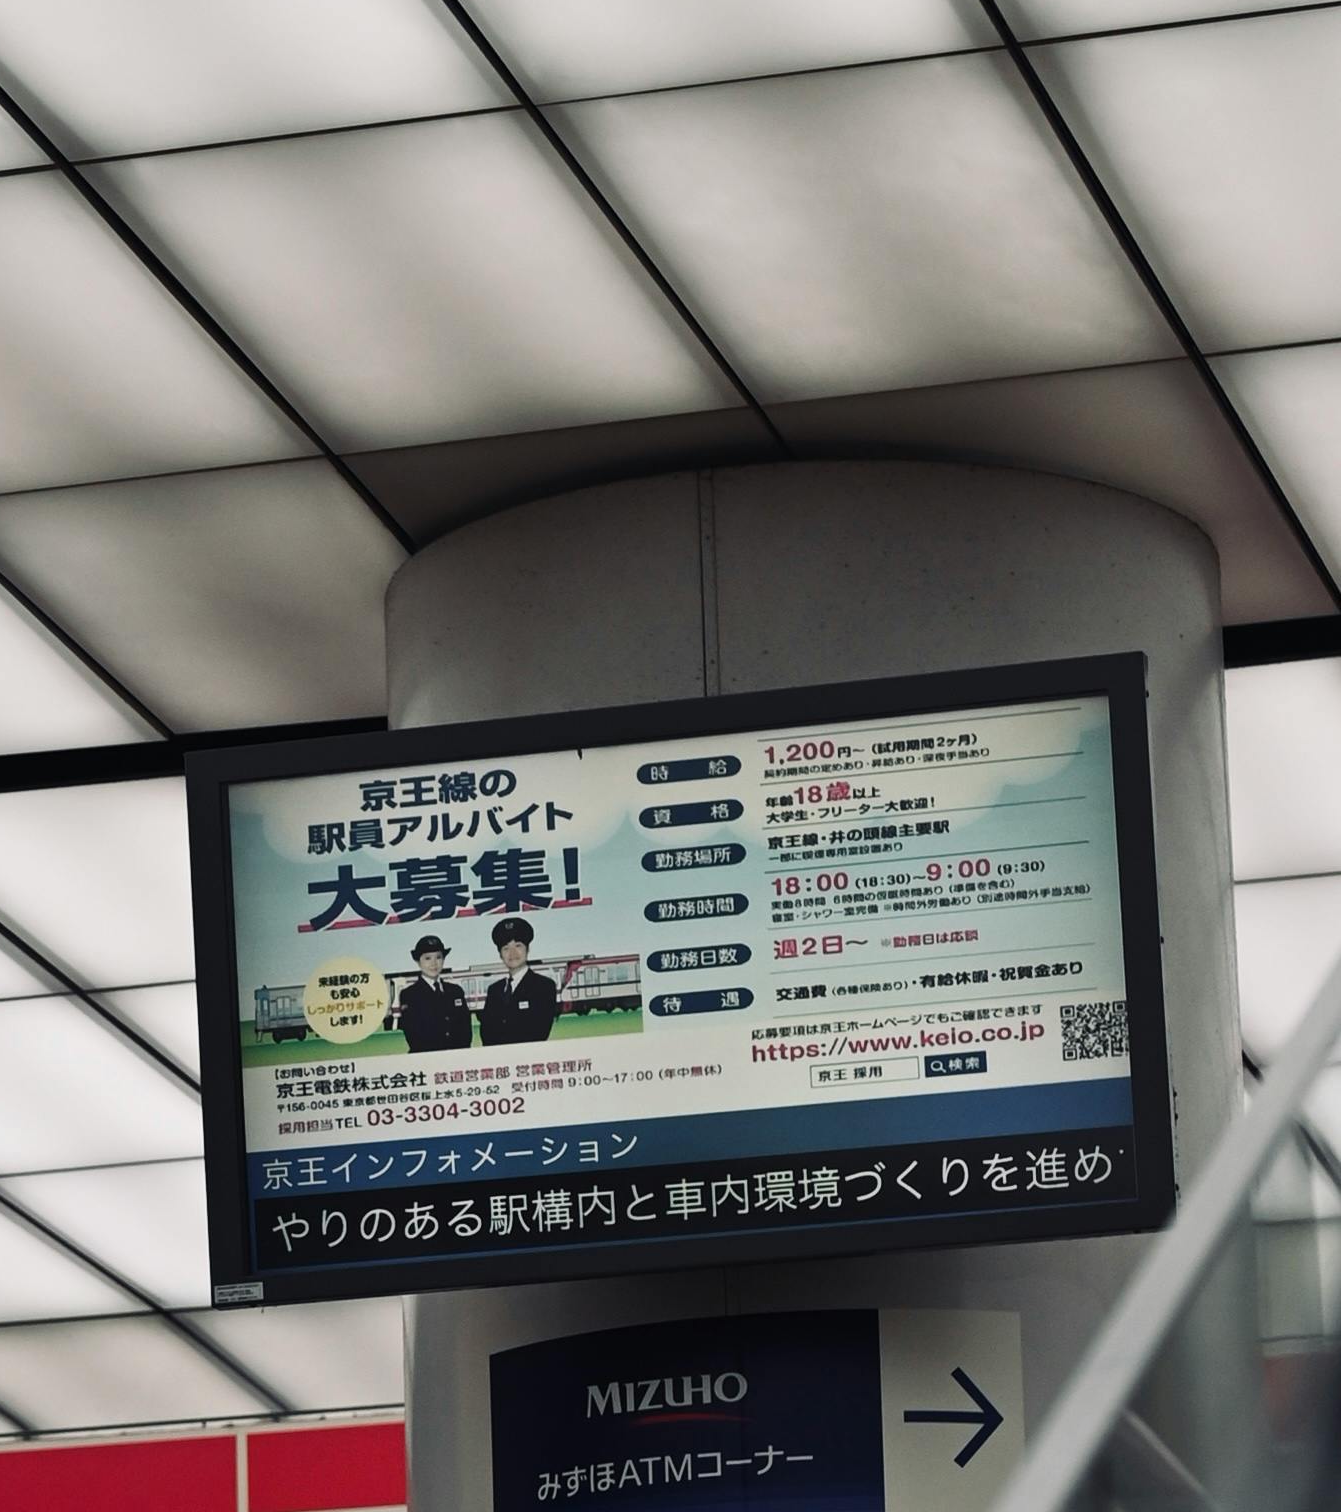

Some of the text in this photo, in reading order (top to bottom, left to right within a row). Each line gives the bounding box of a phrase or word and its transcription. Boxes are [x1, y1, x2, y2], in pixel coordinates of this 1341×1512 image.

[359, 769, 517, 812] 京王線の
[307, 801, 574, 855] 駅員アルバイト
[767, 820, 950, 850] 京王線・井の頭線主要駅
[654, 846, 732, 870] 勤務場所
[307, 847, 582, 930] 大募集!
[658, 897, 735, 919] 勤務時間
[661, 947, 739, 969] 勤務日数
[752, 1020, 1046, 1063] https://www.keio.co.jp
[276, 1071, 428, 1099] 京王電鉄株式会社
[948, 1055, 981, 1072] 検索
[367, 1096, 526, 1128] 03-3304-3002
[261, 1132, 639, 1191] 京王インフォメーション
[271, 1144, 1125, 1253] やりのある駅構内と車内環境づくりを進め
[585, 1371, 749, 1419] MIZUHO
[537, 1444, 814, 1501] みずほATMコーナー
